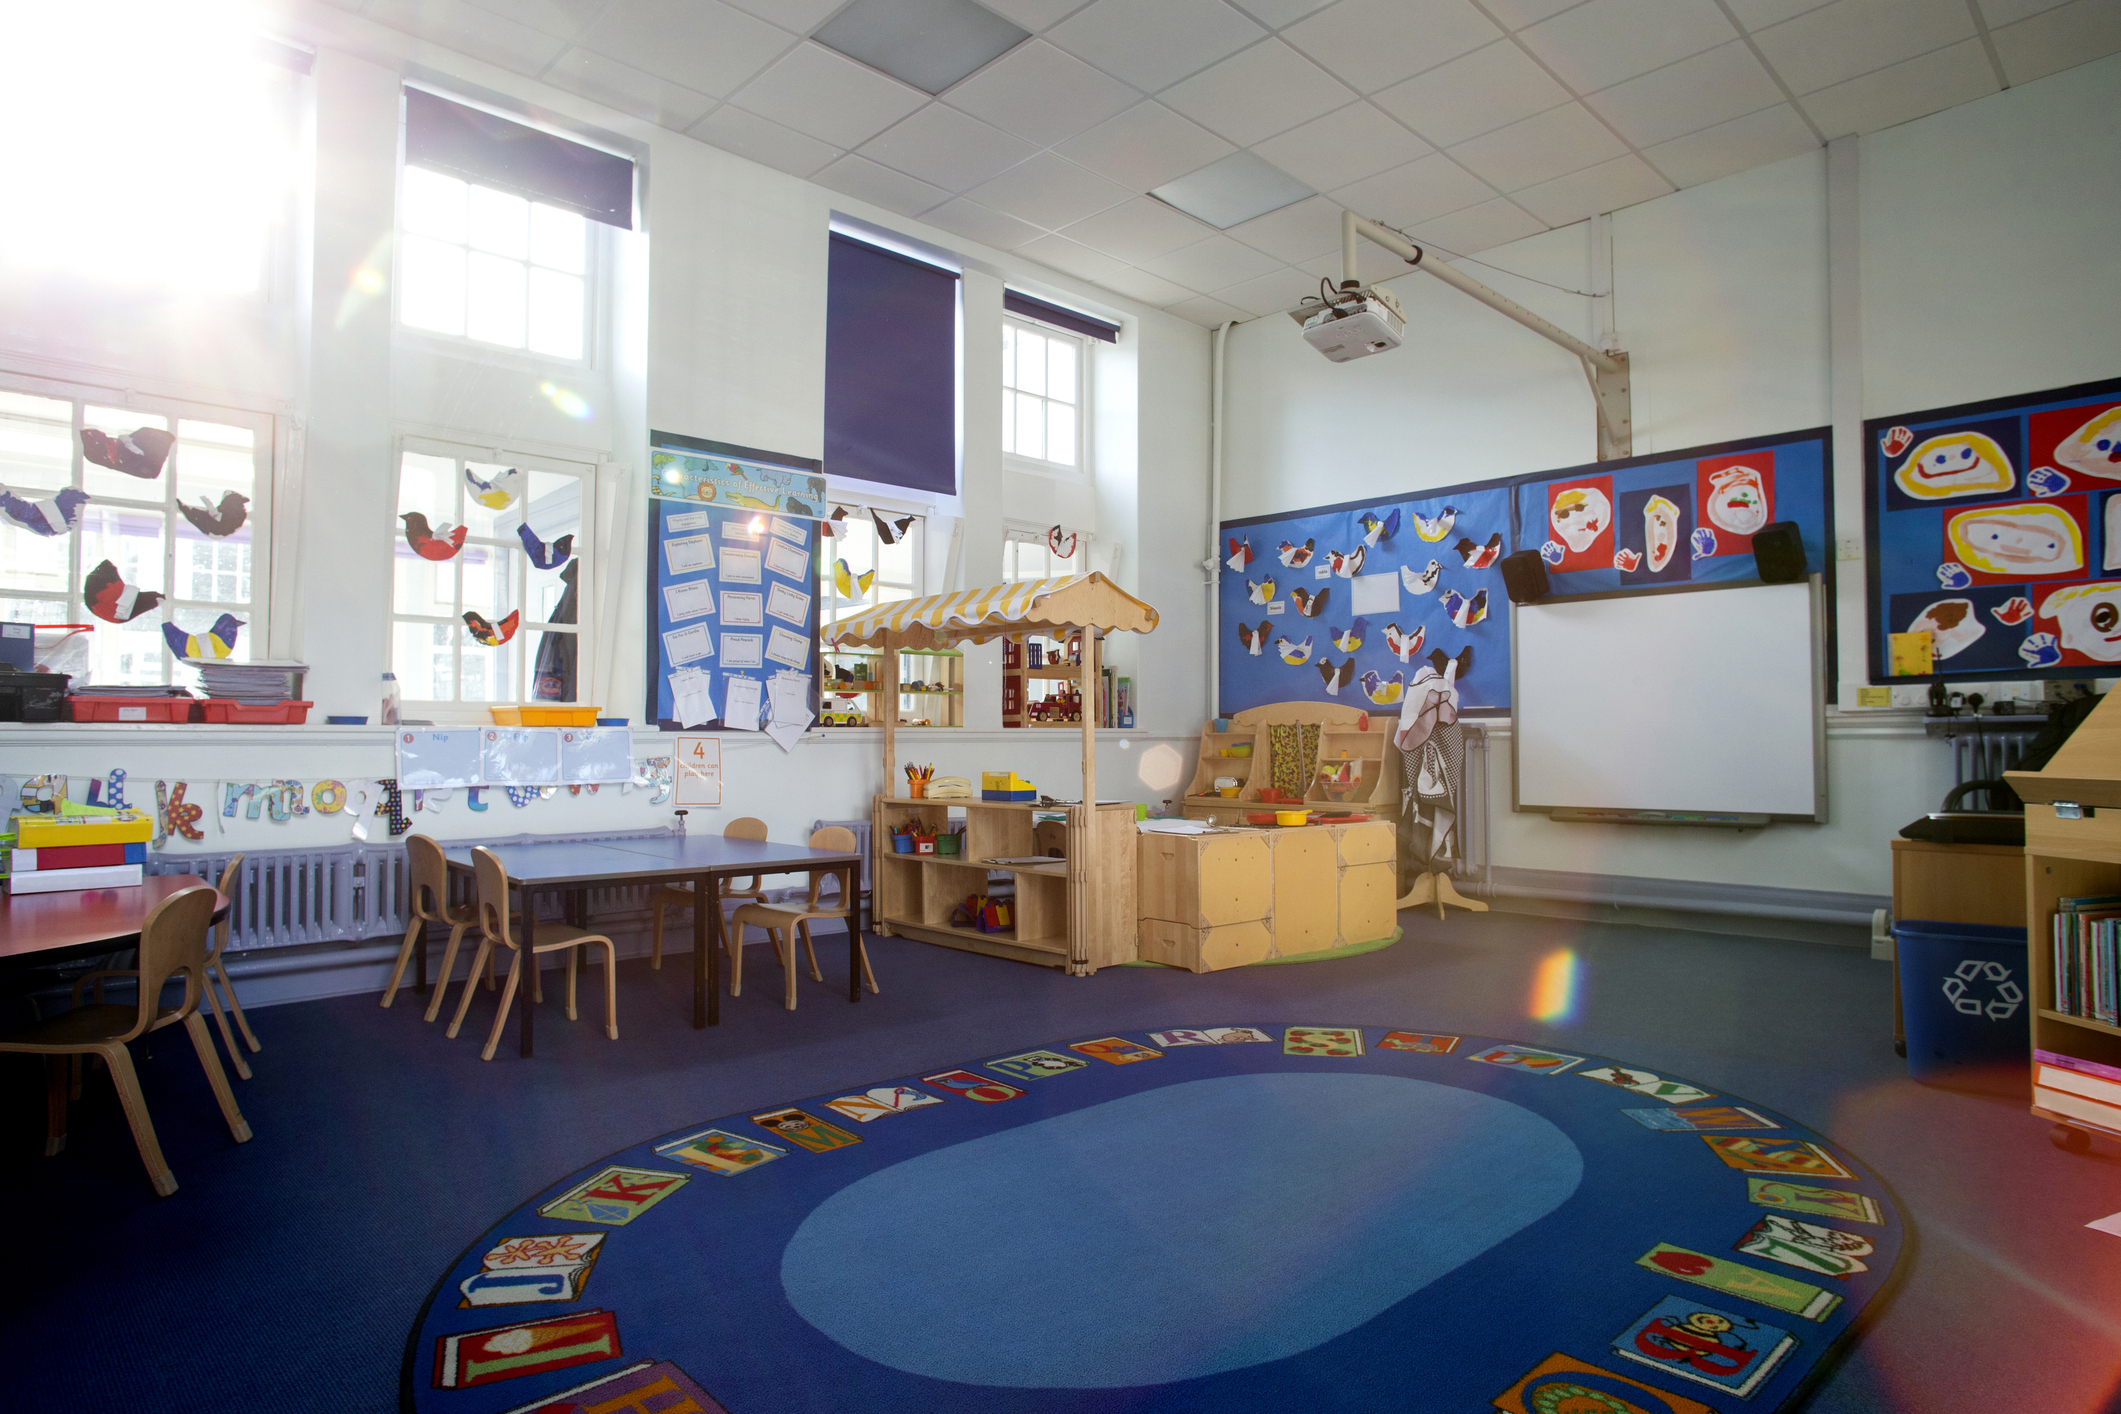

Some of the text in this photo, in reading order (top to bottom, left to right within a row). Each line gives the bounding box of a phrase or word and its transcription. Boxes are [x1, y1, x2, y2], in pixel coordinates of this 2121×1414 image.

[661, 468, 818, 502] Cracteristics of Effective Learning
[432, 734, 449, 743] Nip
[513, 733, 529, 743] Flp
[693, 742, 705, 759] 4
[684, 770, 699, 778] play
[311, 780, 347, 814] o
[1156, 1030, 1210, 1046] R
[987, 1060, 1045, 1081] P
[964, 1086, 1016, 1102] O
[1654, 1081, 1706, 1098] V
[828, 1096, 894, 1120] N
[1673, 1106, 1764, 1128] W
[782, 1124, 856, 1152] M
[584, 1174, 680, 1206] K
[1755, 1238, 1852, 1274] Z
[468, 1273, 565, 1296] J
[1724, 1270, 1802, 1300] A
[1634, 1317, 1758, 1376] B
